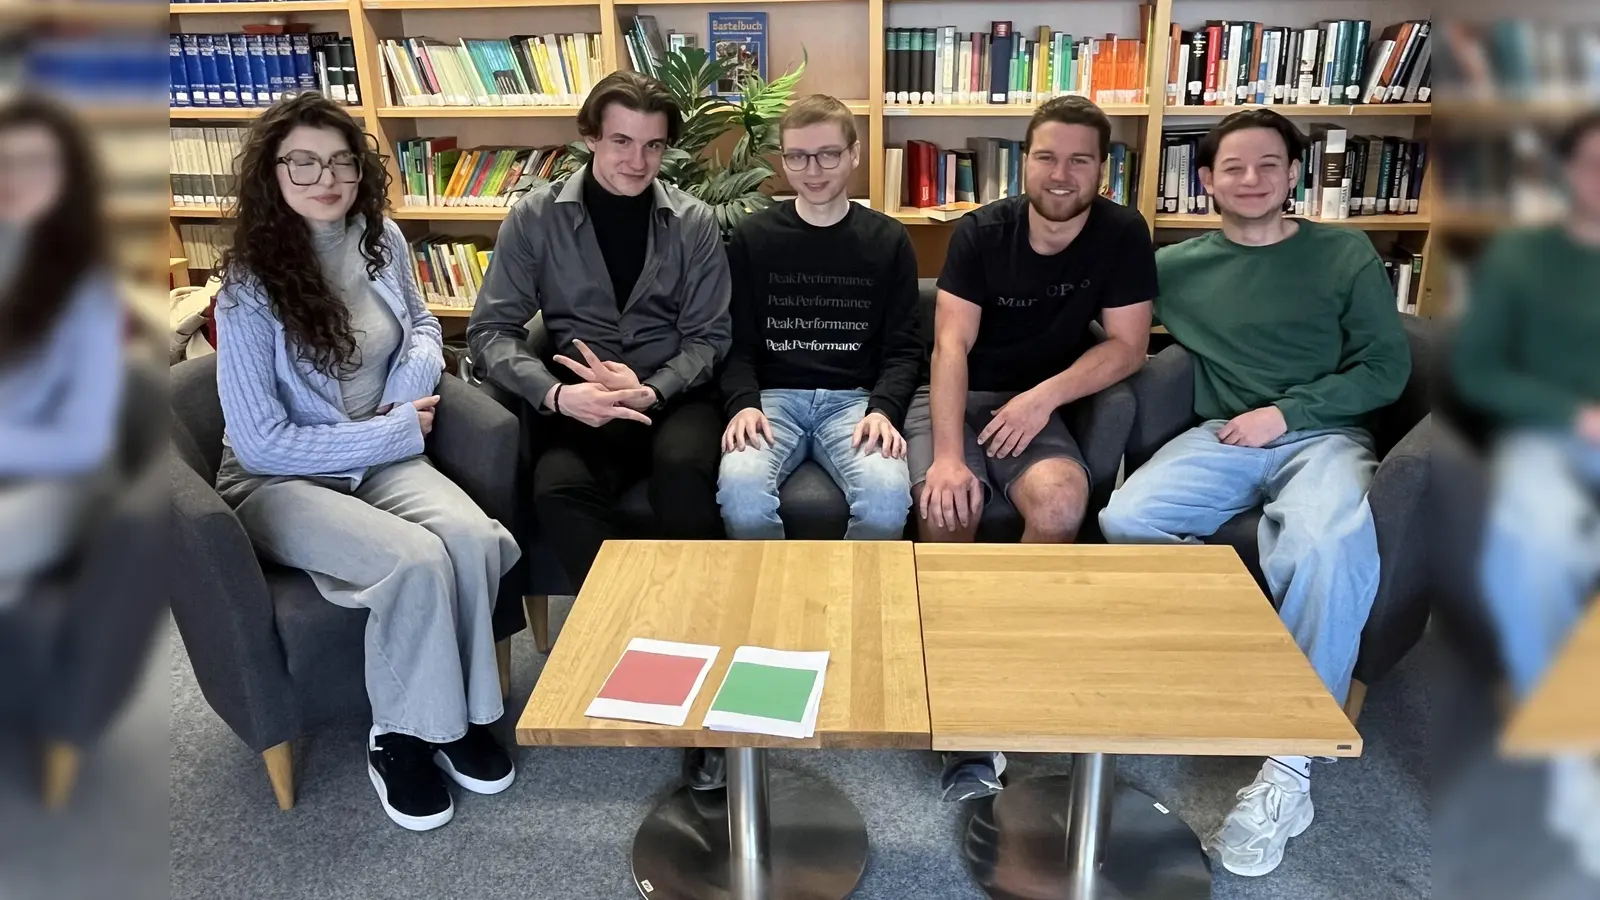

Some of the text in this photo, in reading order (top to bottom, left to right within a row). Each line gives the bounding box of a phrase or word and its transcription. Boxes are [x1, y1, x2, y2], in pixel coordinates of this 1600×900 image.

[712, 20, 762, 30] Bastelbuch
[768, 271, 874, 287] PeakPerformance
[767, 293, 872, 309] PeakPerformance
[997, 296, 1038, 307] Mar
[766, 316, 869, 331] PeakPerformance
